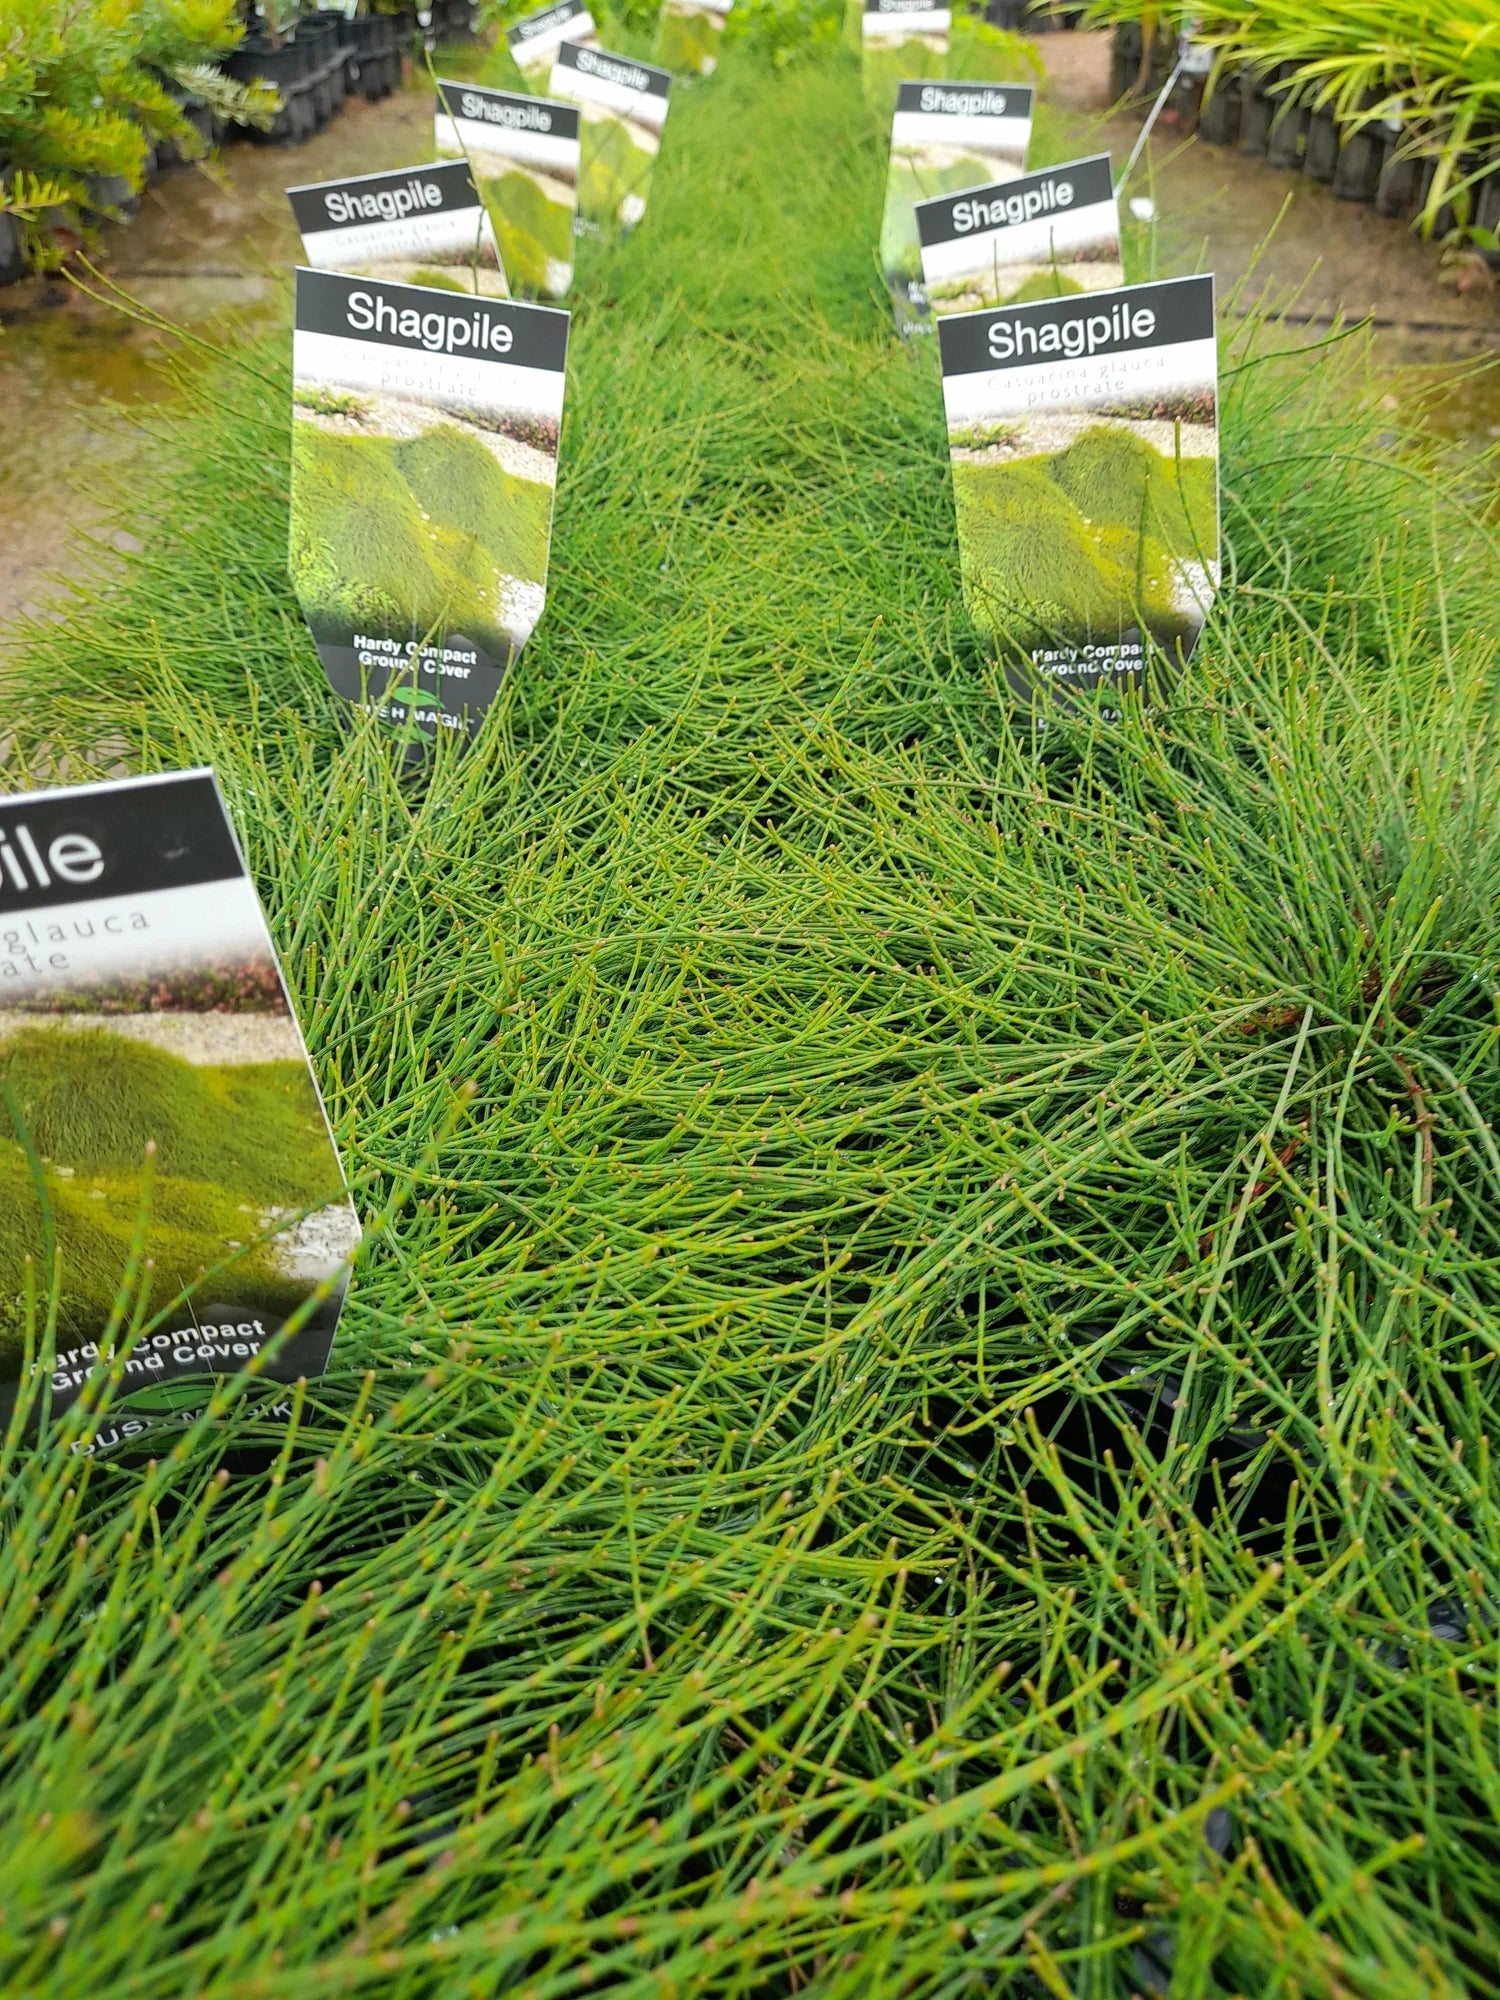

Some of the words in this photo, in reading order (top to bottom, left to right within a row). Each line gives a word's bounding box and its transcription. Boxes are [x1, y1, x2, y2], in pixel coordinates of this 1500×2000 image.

[575, 49, 650, 91] Shagpile
[461, 92, 552, 132] Shagpile
[919, 86, 1007, 117] Shagpile
[324, 179, 443, 223] Shagpile
[951, 180, 1074, 233] Shagpile
[346, 291, 514, 353] Shagpile
[987, 302, 1157, 360] Shagpile
[1027, 380, 1126, 408] prostrate
[353, 634, 402, 656] Hardy
[405, 641, 477, 665] Compact
[423, 659, 471, 679] Cover
[1082, 643, 1155, 659] Compat
[0, 824, 105, 893] ile
[3, 911, 150, 954] glauca
[1, 952, 71, 977] ate
[172, 1341, 261, 1364] Cover
